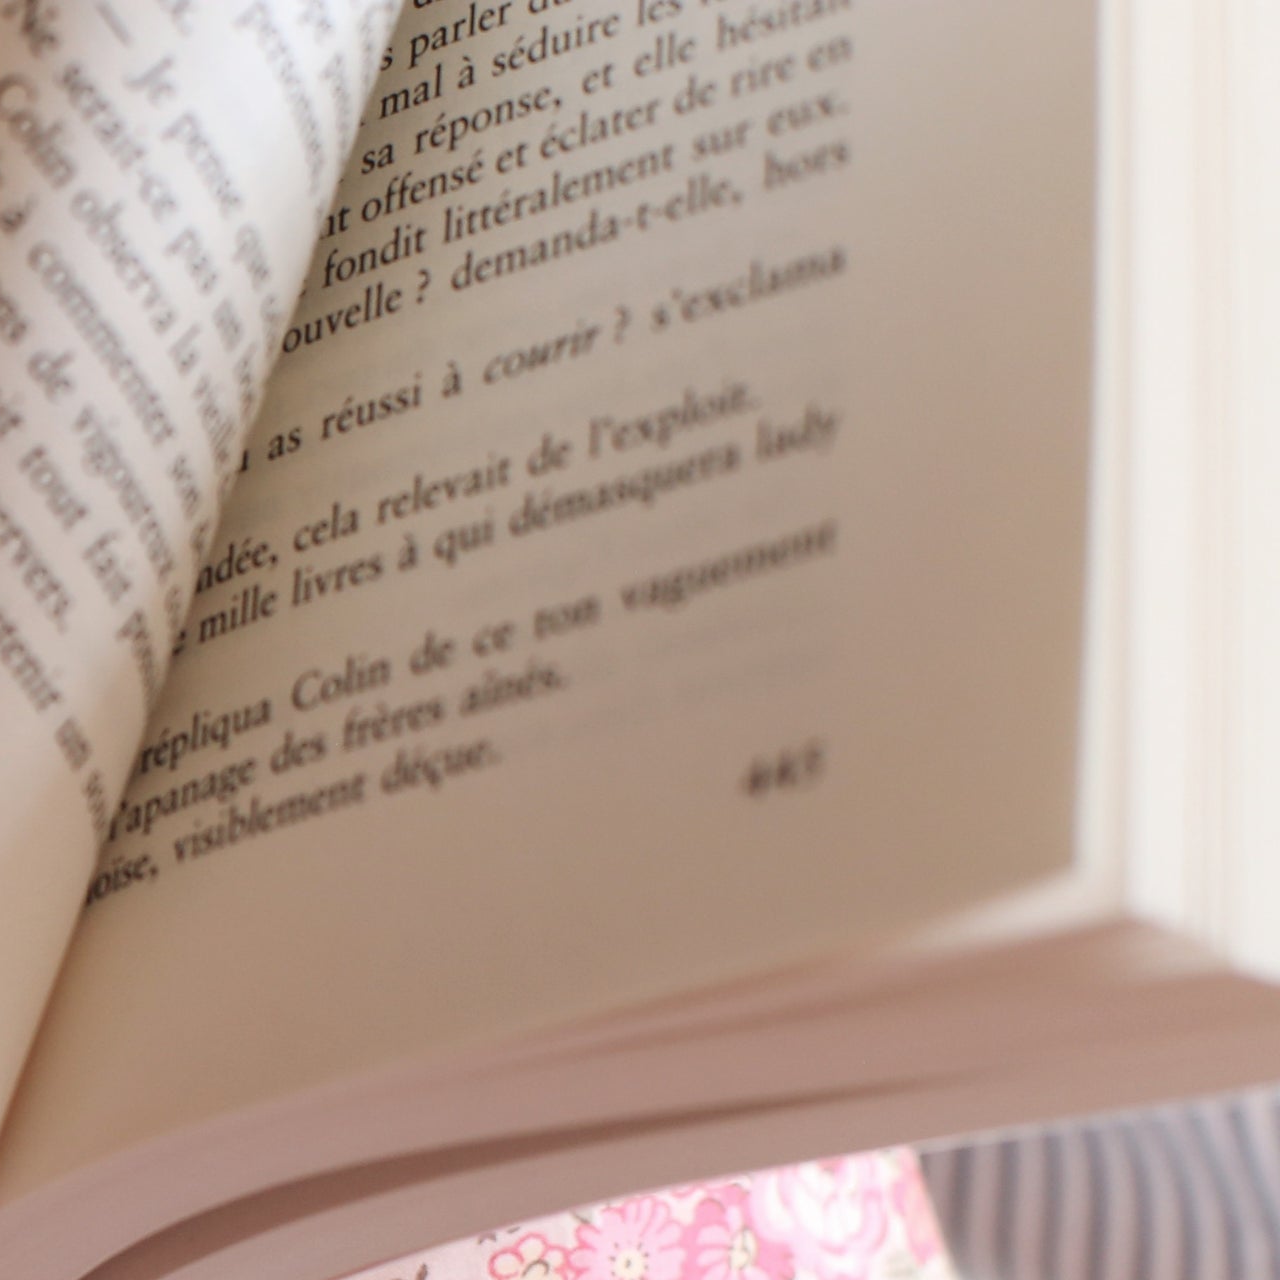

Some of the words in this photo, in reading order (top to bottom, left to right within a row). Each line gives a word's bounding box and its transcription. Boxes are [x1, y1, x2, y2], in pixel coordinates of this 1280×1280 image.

[361, 143, 394, 175] sa
[414, 85, 562, 155] réponse,
[582, 62, 614, 95] et
[633, 31, 697, 77] elle
[379, 63, 441, 119] mal
[457, 56, 476, 90] à
[491, 13, 622, 78] séduire
[408, 2, 512, 69] parler
[53, 62, 180, 222] serait-ce
[162, 225, 220, 297] pas
[161, 112, 246, 222] pense
[322, 223, 427, 289] fondit
[443, 143, 675, 245] littéralement
[691, 117, 753, 162] sur
[360, 148, 485, 222] offensé
[496, 141, 528, 175] et
[540, 98, 661, 160] éclater
[672, 74, 718, 116] de
[729, 52, 794, 99] rire
[806, 34, 854, 72] en
[67, 188, 175, 336] observa
[167, 322, 204, 375] la
[450, 171, 744, 292] demanda-t-elle,
[762, 138, 851, 191] hors
[26, 239, 176, 448] commenter
[267, 425, 302, 461] as
[320, 370, 422, 441] réussi
[443, 361, 463, 399] à
[482, 317, 603, 385] courir
[17, 444, 91, 533] tout
[83, 528, 133, 609] fait
[27, 348, 77, 405] de
[72, 403, 176, 585] vigoureux
[197, 583, 278, 644] mille
[292, 552, 383, 608] livres
[398, 532, 418, 572] à
[433, 505, 495, 567] qui
[507, 441, 743, 538] démasquera
[755, 402, 842, 464] lady
[292, 501, 361, 553] cela
[376, 453, 511, 525] relevait
[526, 432, 572, 477] de
[54, 715, 92, 772] un
[108, 755, 258, 842] l'apanage
[269, 731, 327, 775] des
[341, 695, 446, 752] frères
[459, 657, 569, 717] aînés.
[140, 697, 272, 774] répliqua
[291, 652, 392, 712] Colin
[408, 627, 454, 676] de
[472, 619, 516, 658] ce
[534, 594, 602, 640] ton
[173, 771, 368, 864] visiblement
[380, 738, 503, 795] déçue.
